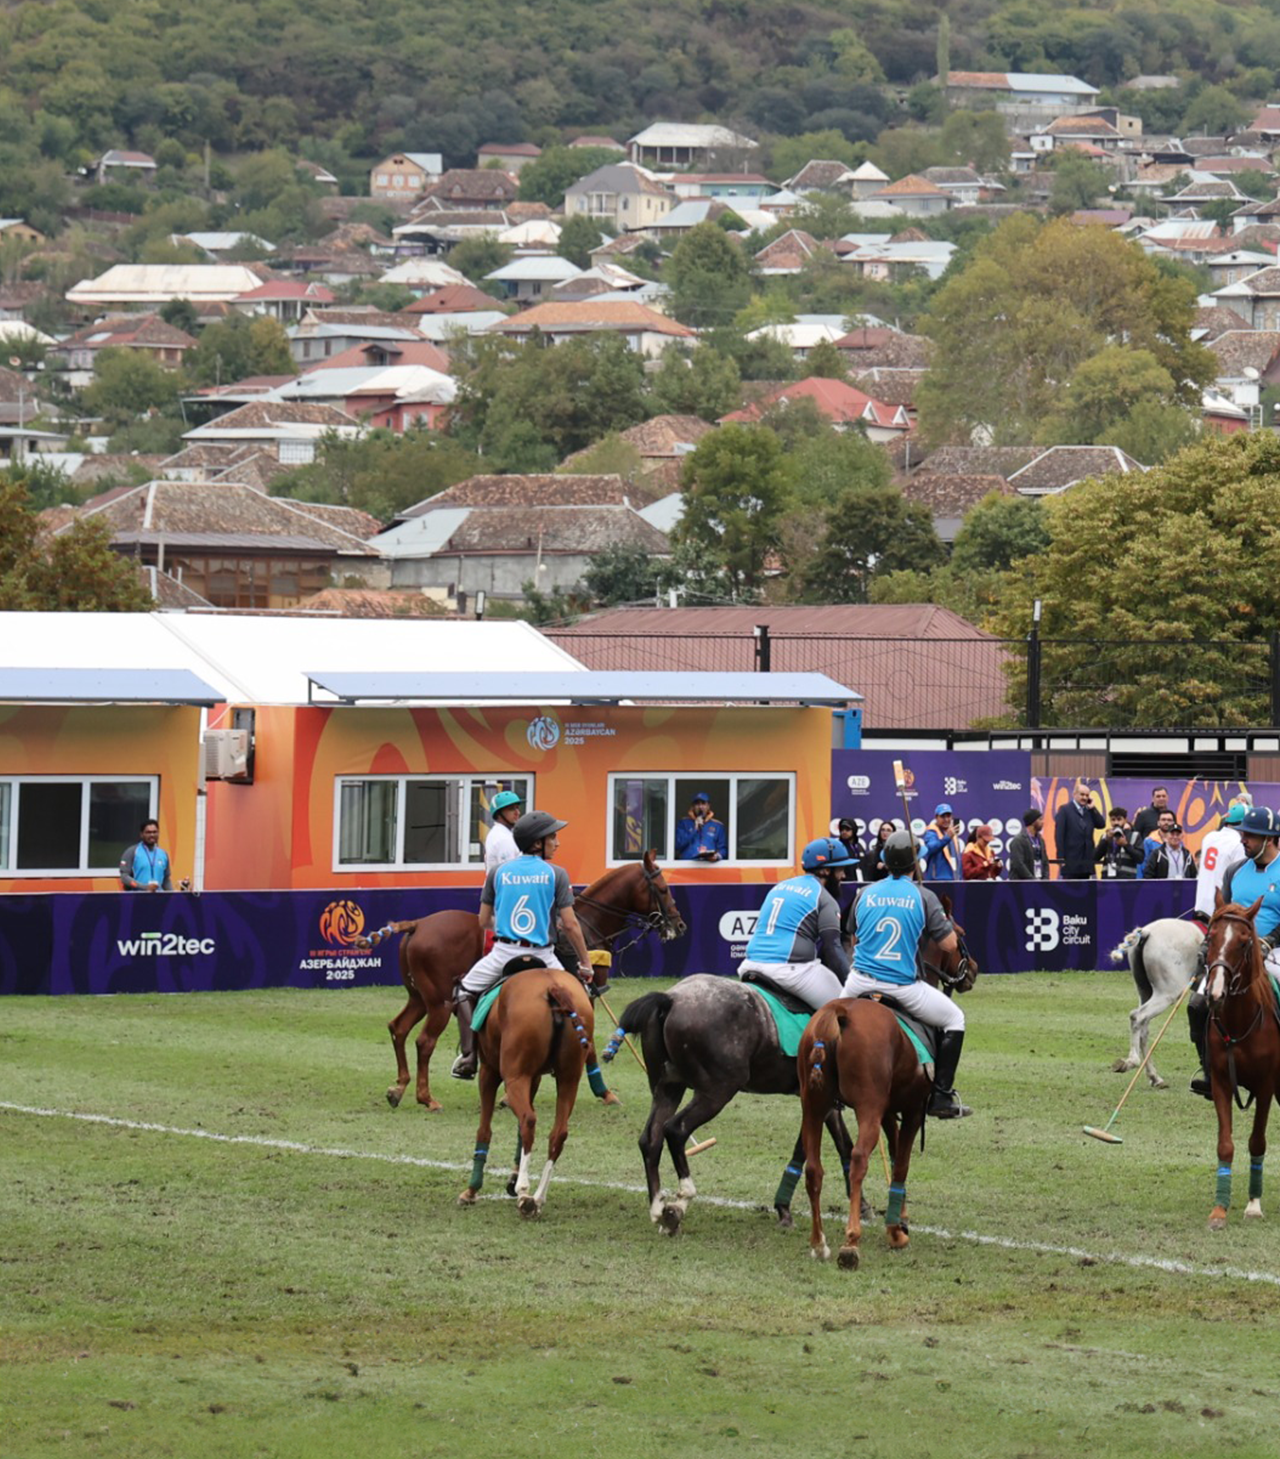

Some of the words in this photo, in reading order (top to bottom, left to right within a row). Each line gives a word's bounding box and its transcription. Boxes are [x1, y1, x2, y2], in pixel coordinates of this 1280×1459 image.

[564, 737, 585, 745] 2025
[1204, 847, 1218, 870] 6
[502, 872, 549, 885] Kuwait
[776, 883, 813, 897] uwait
[866, 894, 915, 910] Kuwait
[511, 895, 536, 935] 6
[766, 897, 785, 935] 1
[1063, 914, 1087, 925] Baku
[731, 917, 759, 936] AZ
[1062, 925, 1079, 937] city
[117, 932, 215, 956] win2tec
[875, 917, 902, 961] 2
[1062, 935, 1091, 945] circuit
[300, 957, 381, 970] АЗЕРБАЙДЖАН
[326, 970, 355, 981] 2025
